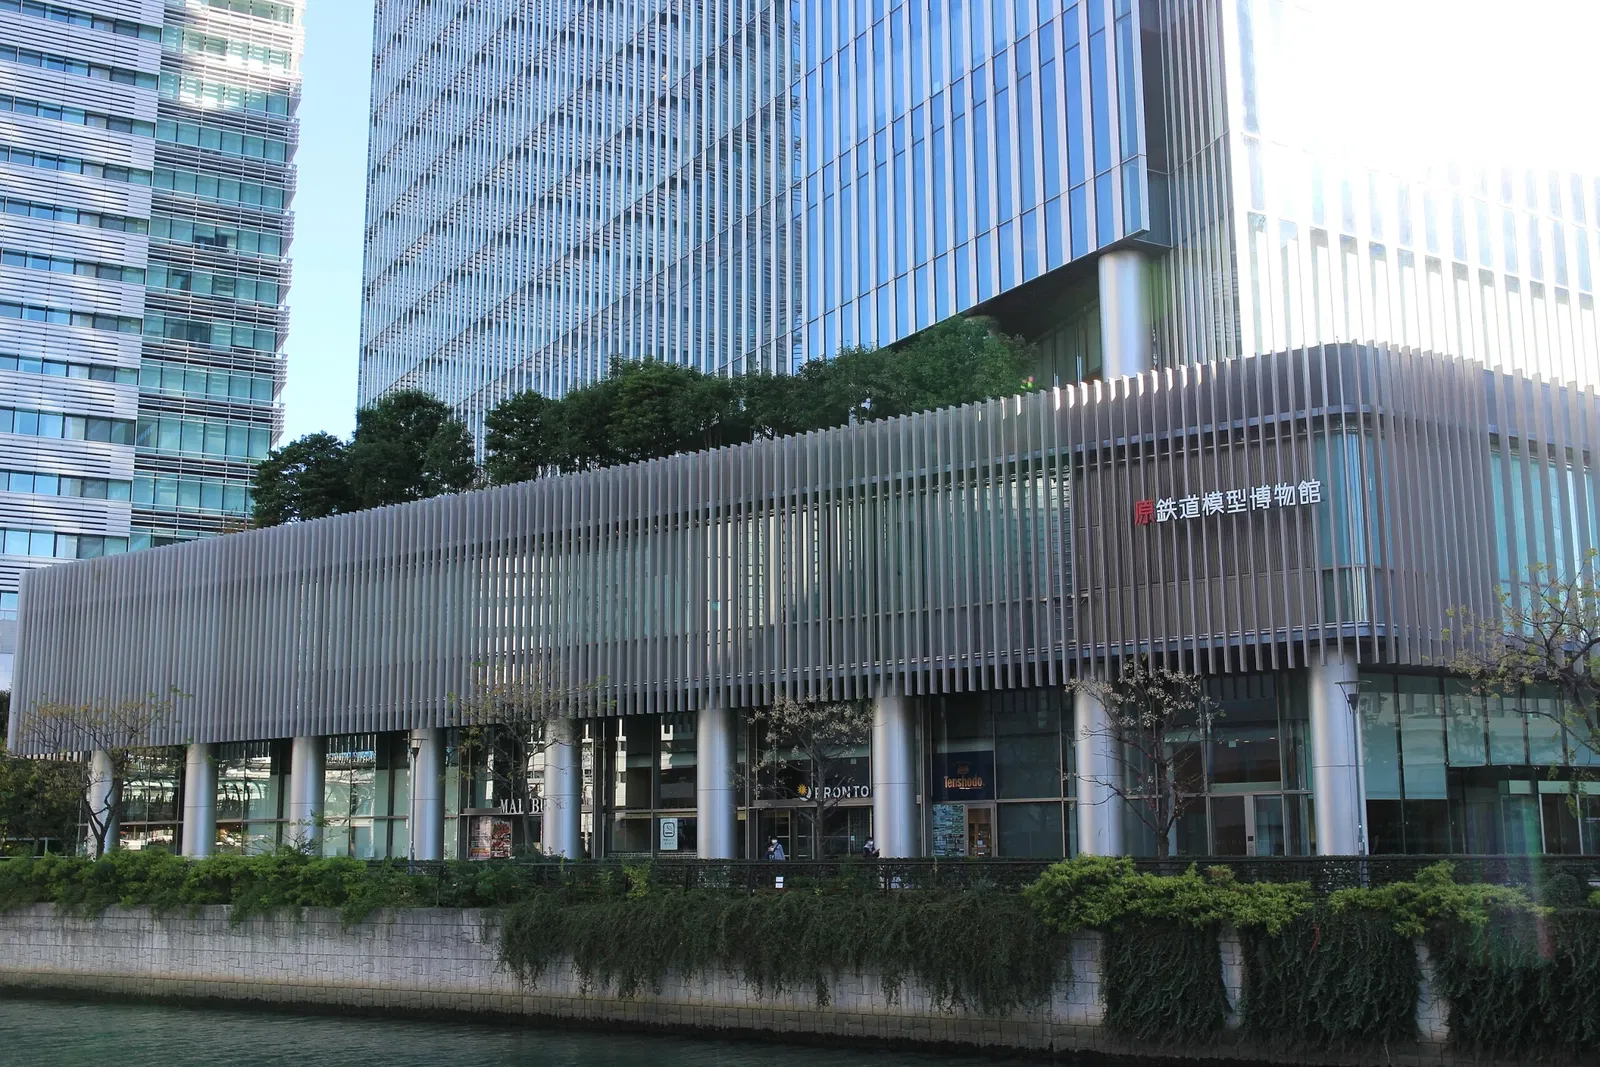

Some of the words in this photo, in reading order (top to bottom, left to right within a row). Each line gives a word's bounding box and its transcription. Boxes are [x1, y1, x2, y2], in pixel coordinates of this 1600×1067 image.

[1134, 478, 1321, 524] 原鉄道模型博物館
[943, 774, 983, 788] Tenshodo
[500, 798, 544, 814] MALB
